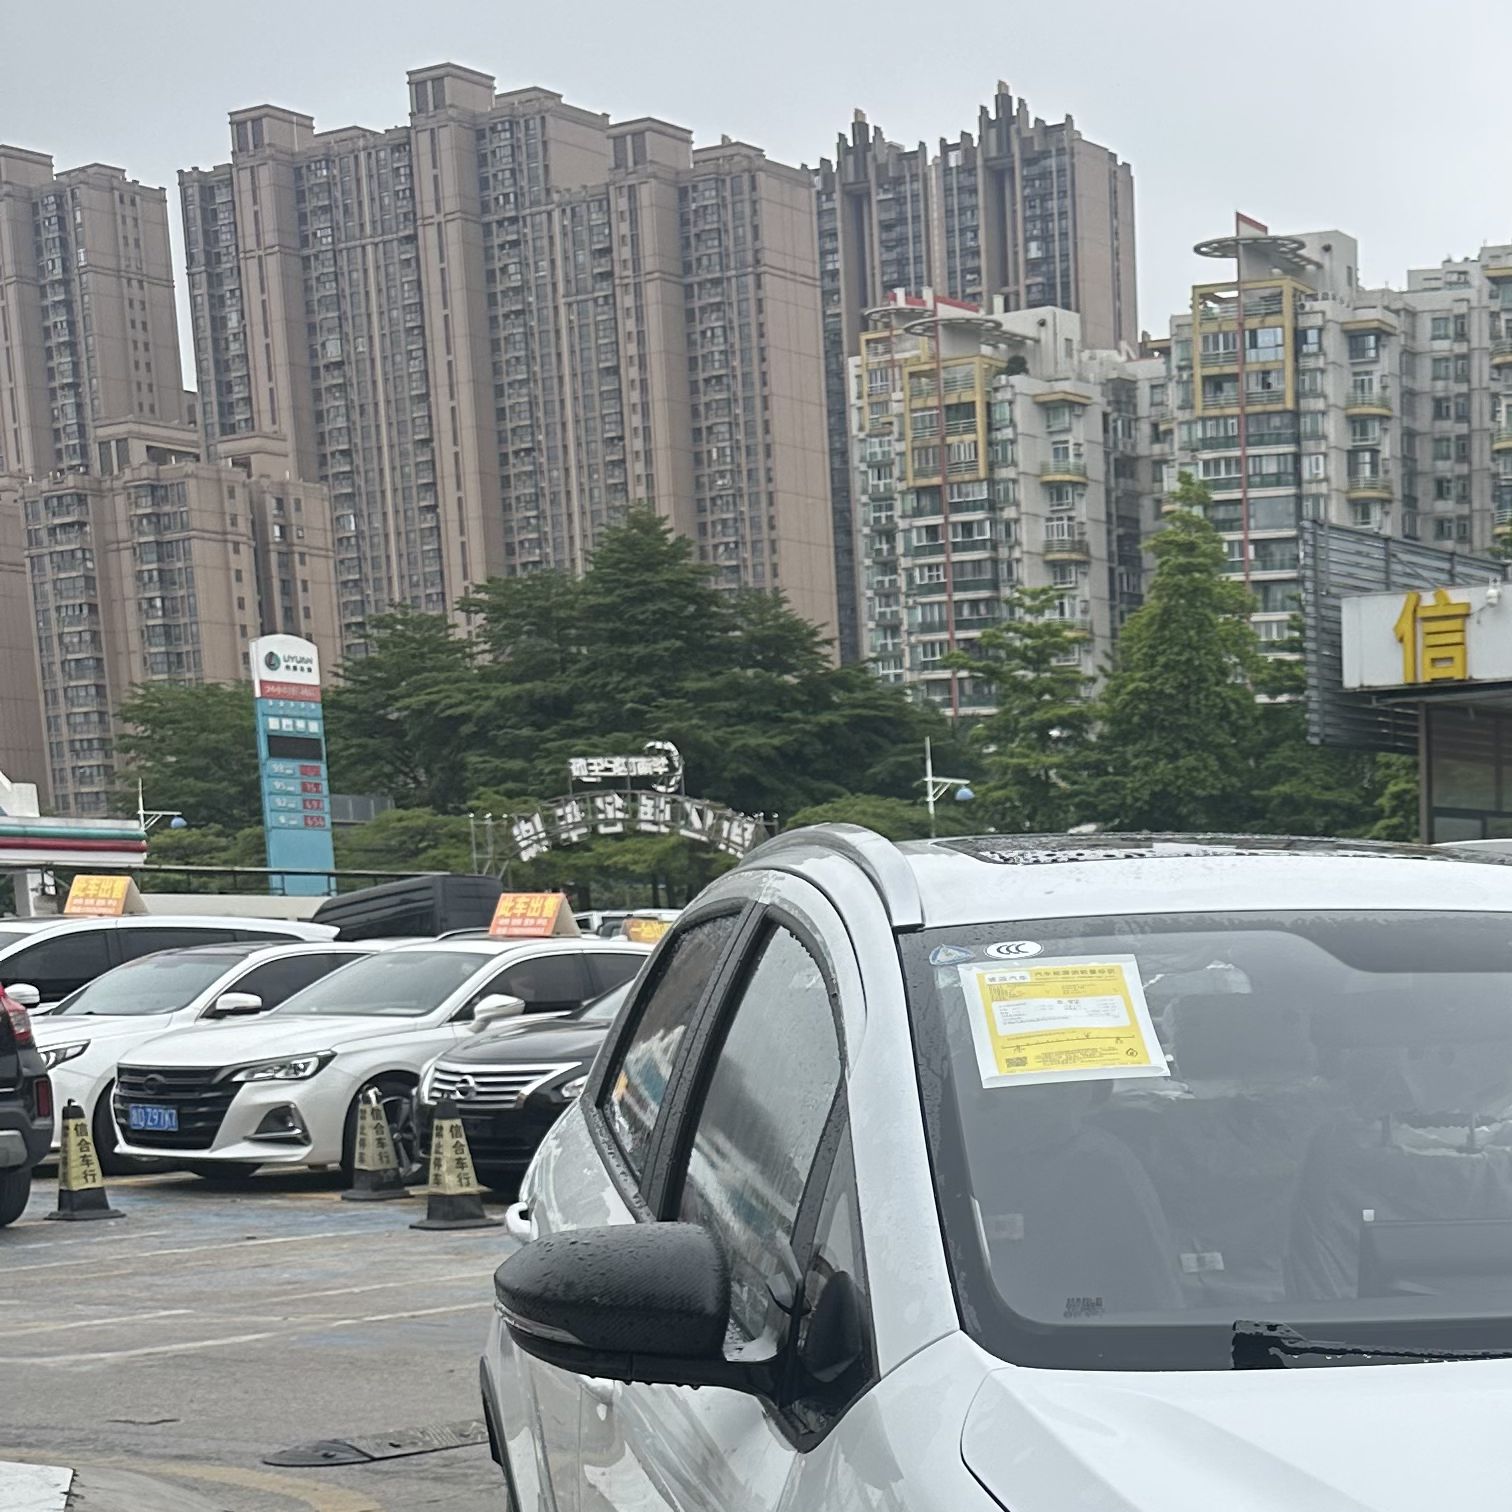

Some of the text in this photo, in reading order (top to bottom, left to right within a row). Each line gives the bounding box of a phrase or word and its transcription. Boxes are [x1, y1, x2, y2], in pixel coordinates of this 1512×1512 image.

[496, 895, 558, 918] 此车出售
[996, 942, 1030, 955] CCC
[74, 1123, 97, 1184] 信合车行
[449, 1124, 471, 1187] 信合车行
